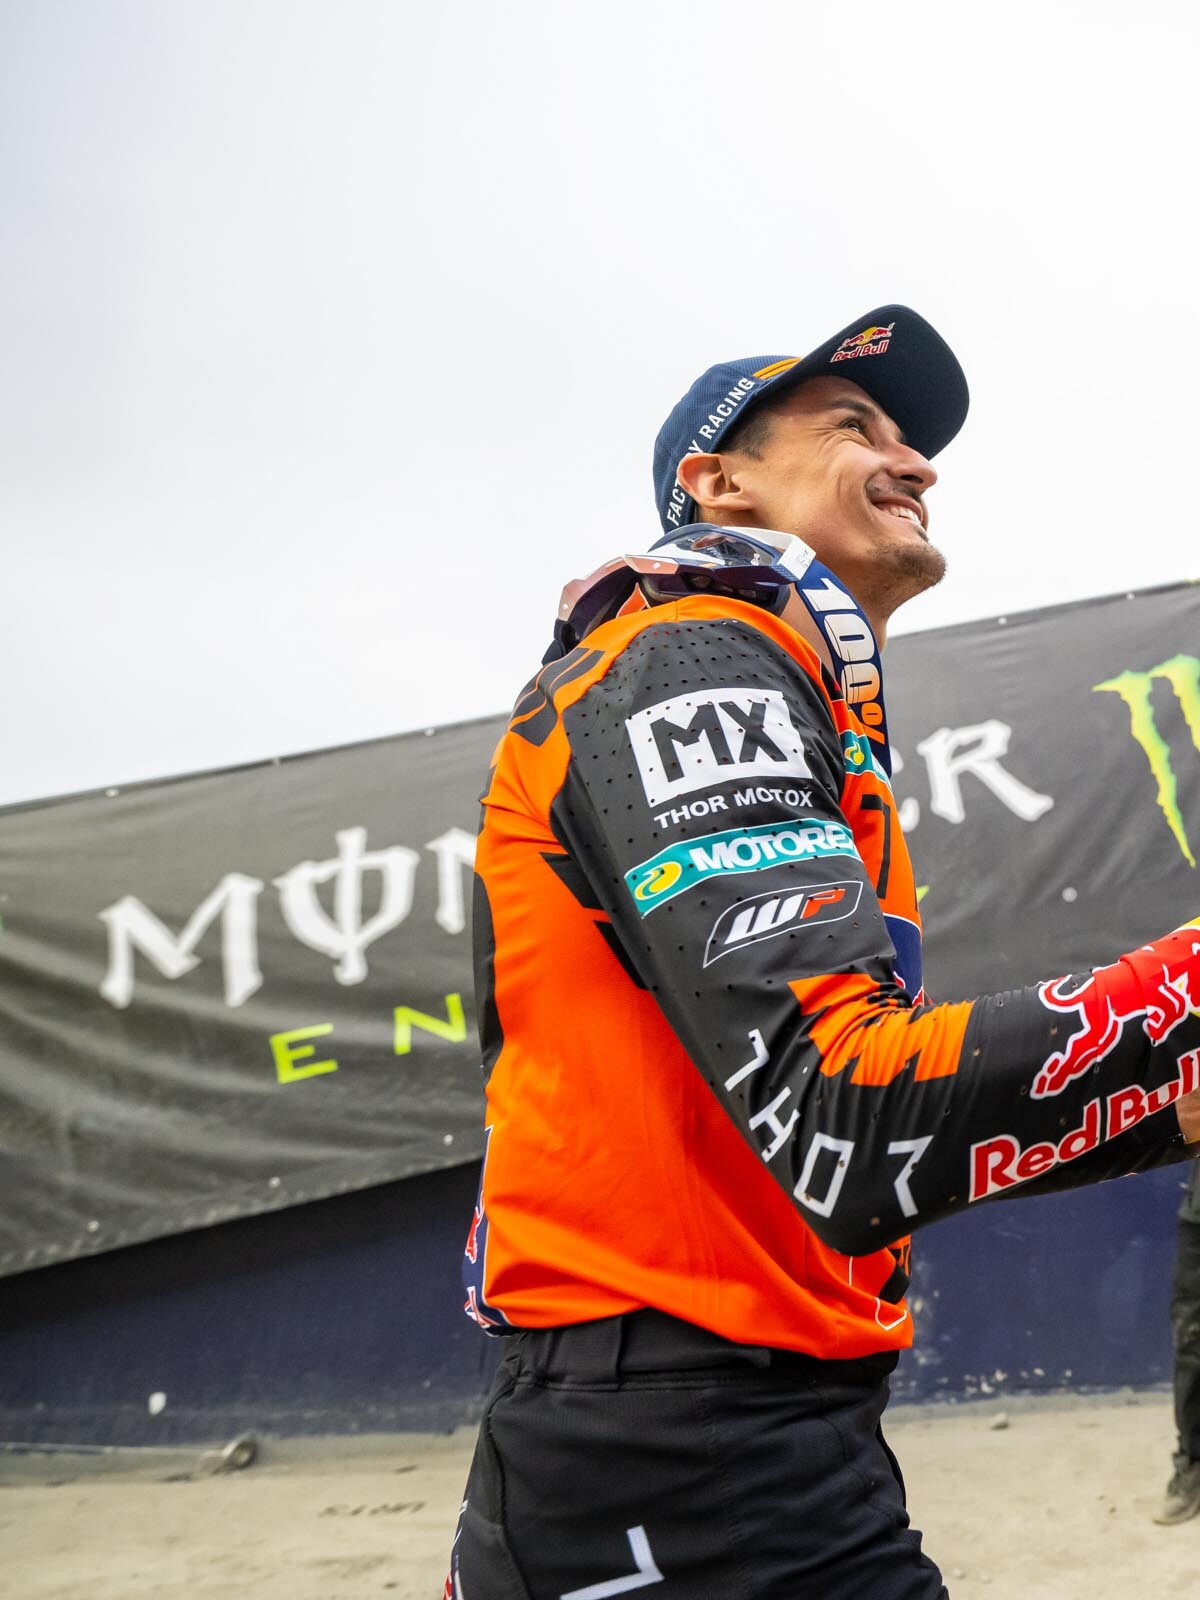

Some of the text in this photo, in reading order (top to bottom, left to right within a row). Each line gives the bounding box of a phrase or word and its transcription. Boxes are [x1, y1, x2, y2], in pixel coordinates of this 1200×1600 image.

[830, 339, 889, 362] Red Bull
[699, 377, 755, 440] RACING
[801, 577, 886, 745] 100%
[650, 700, 787, 782] MX
[653, 786, 813, 829] THOR MOTOX
[689, 825, 854, 872] MOTORE
[724, 888, 846, 945] WP
[969, 1098, 1099, 1203] Red
